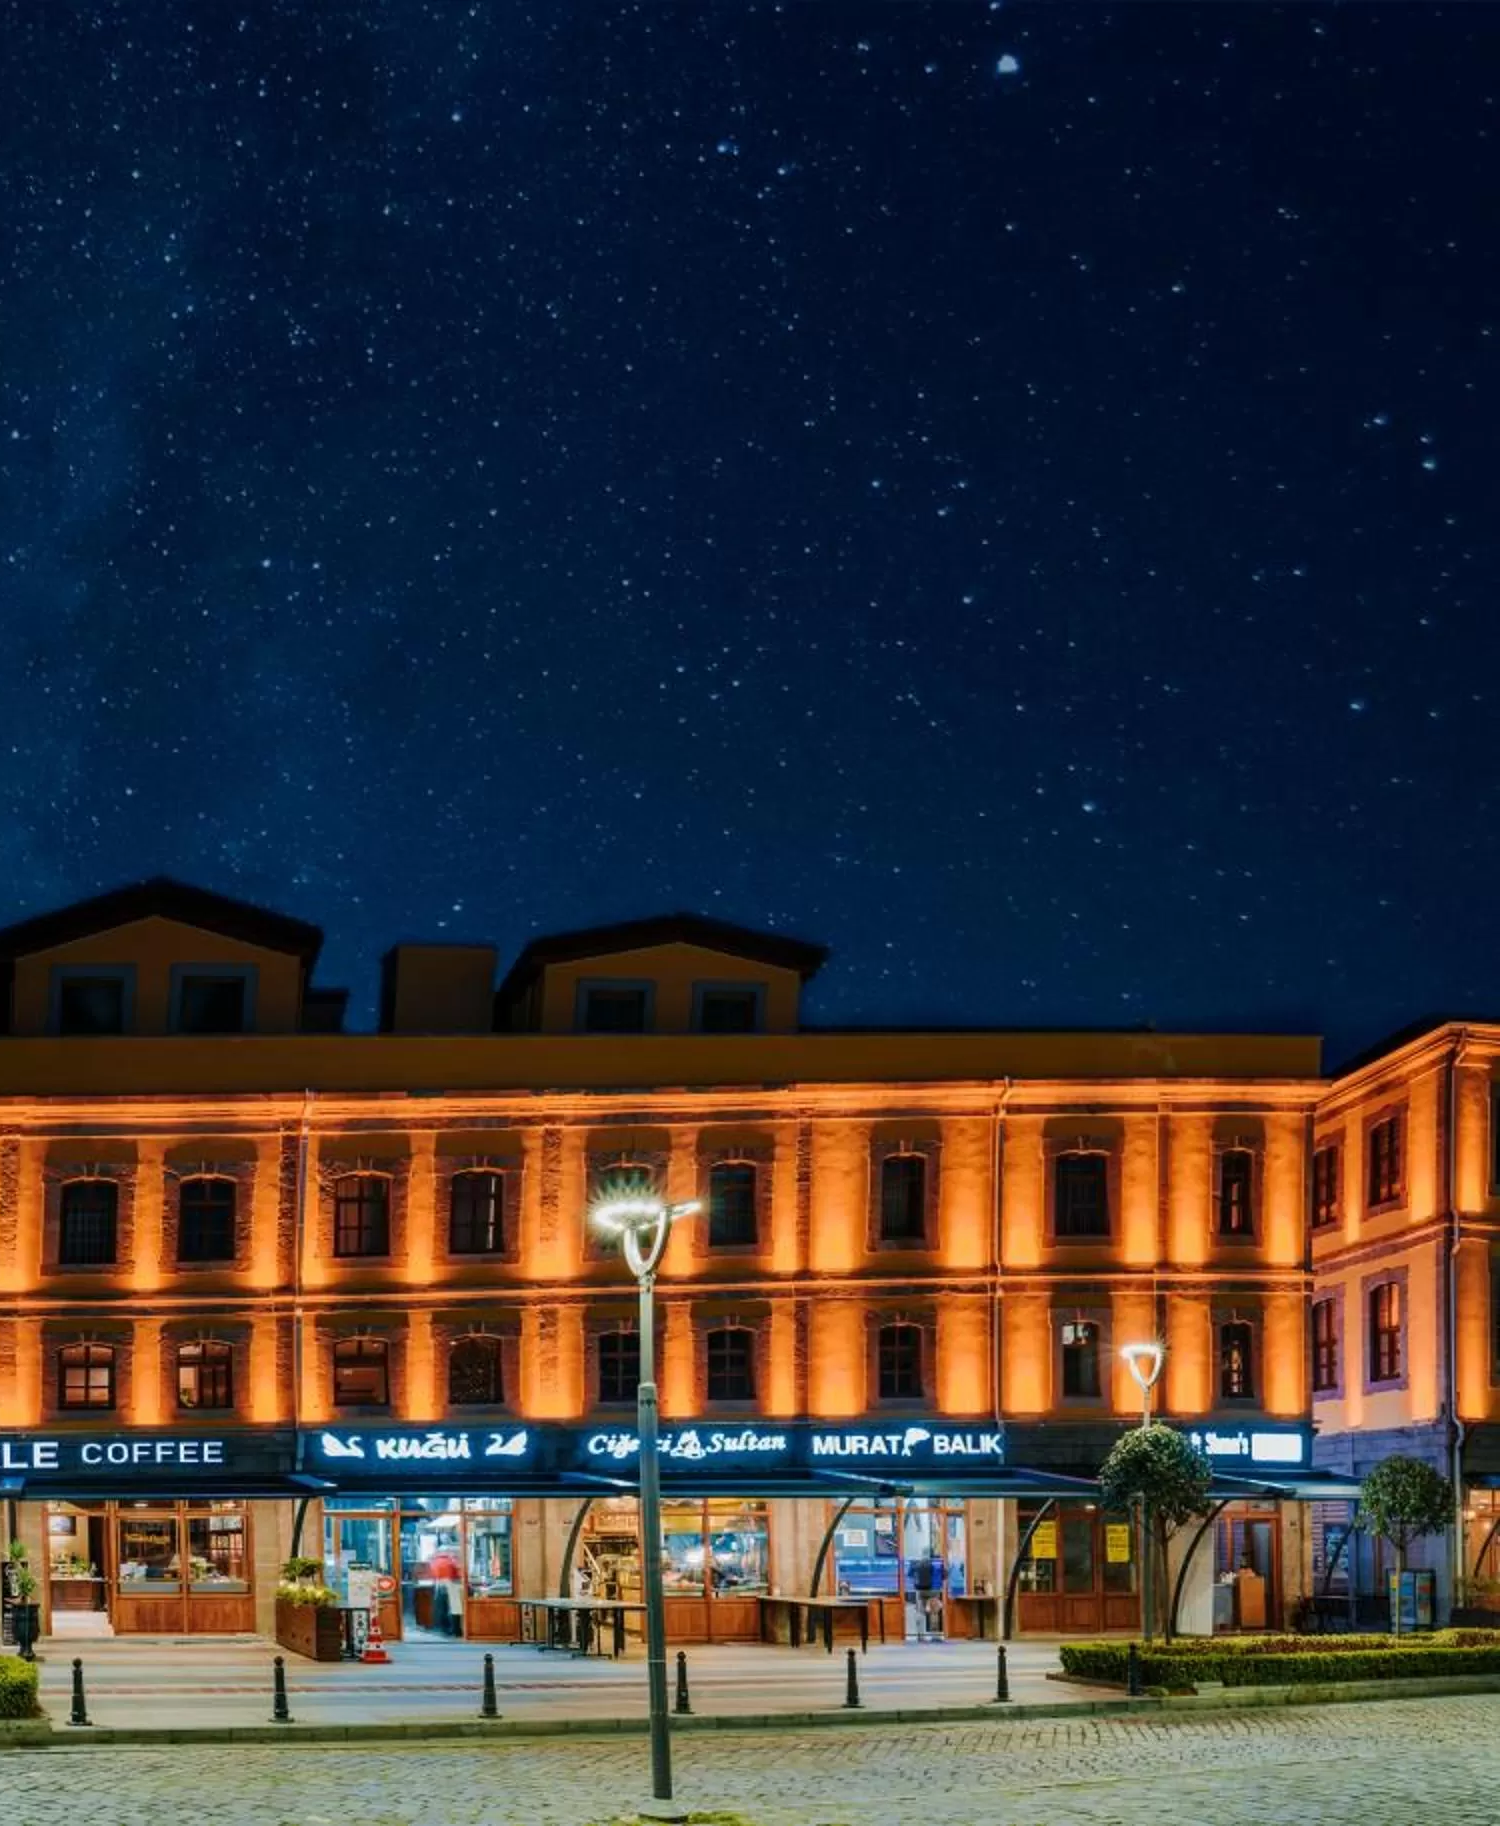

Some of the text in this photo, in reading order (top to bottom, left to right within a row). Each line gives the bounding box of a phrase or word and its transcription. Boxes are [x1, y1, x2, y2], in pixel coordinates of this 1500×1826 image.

[706, 1430, 786, 1453] Sultan
[812, 1434, 1002, 1455] MURAT BALIK
[81, 1442, 223, 1464] COFFEE
